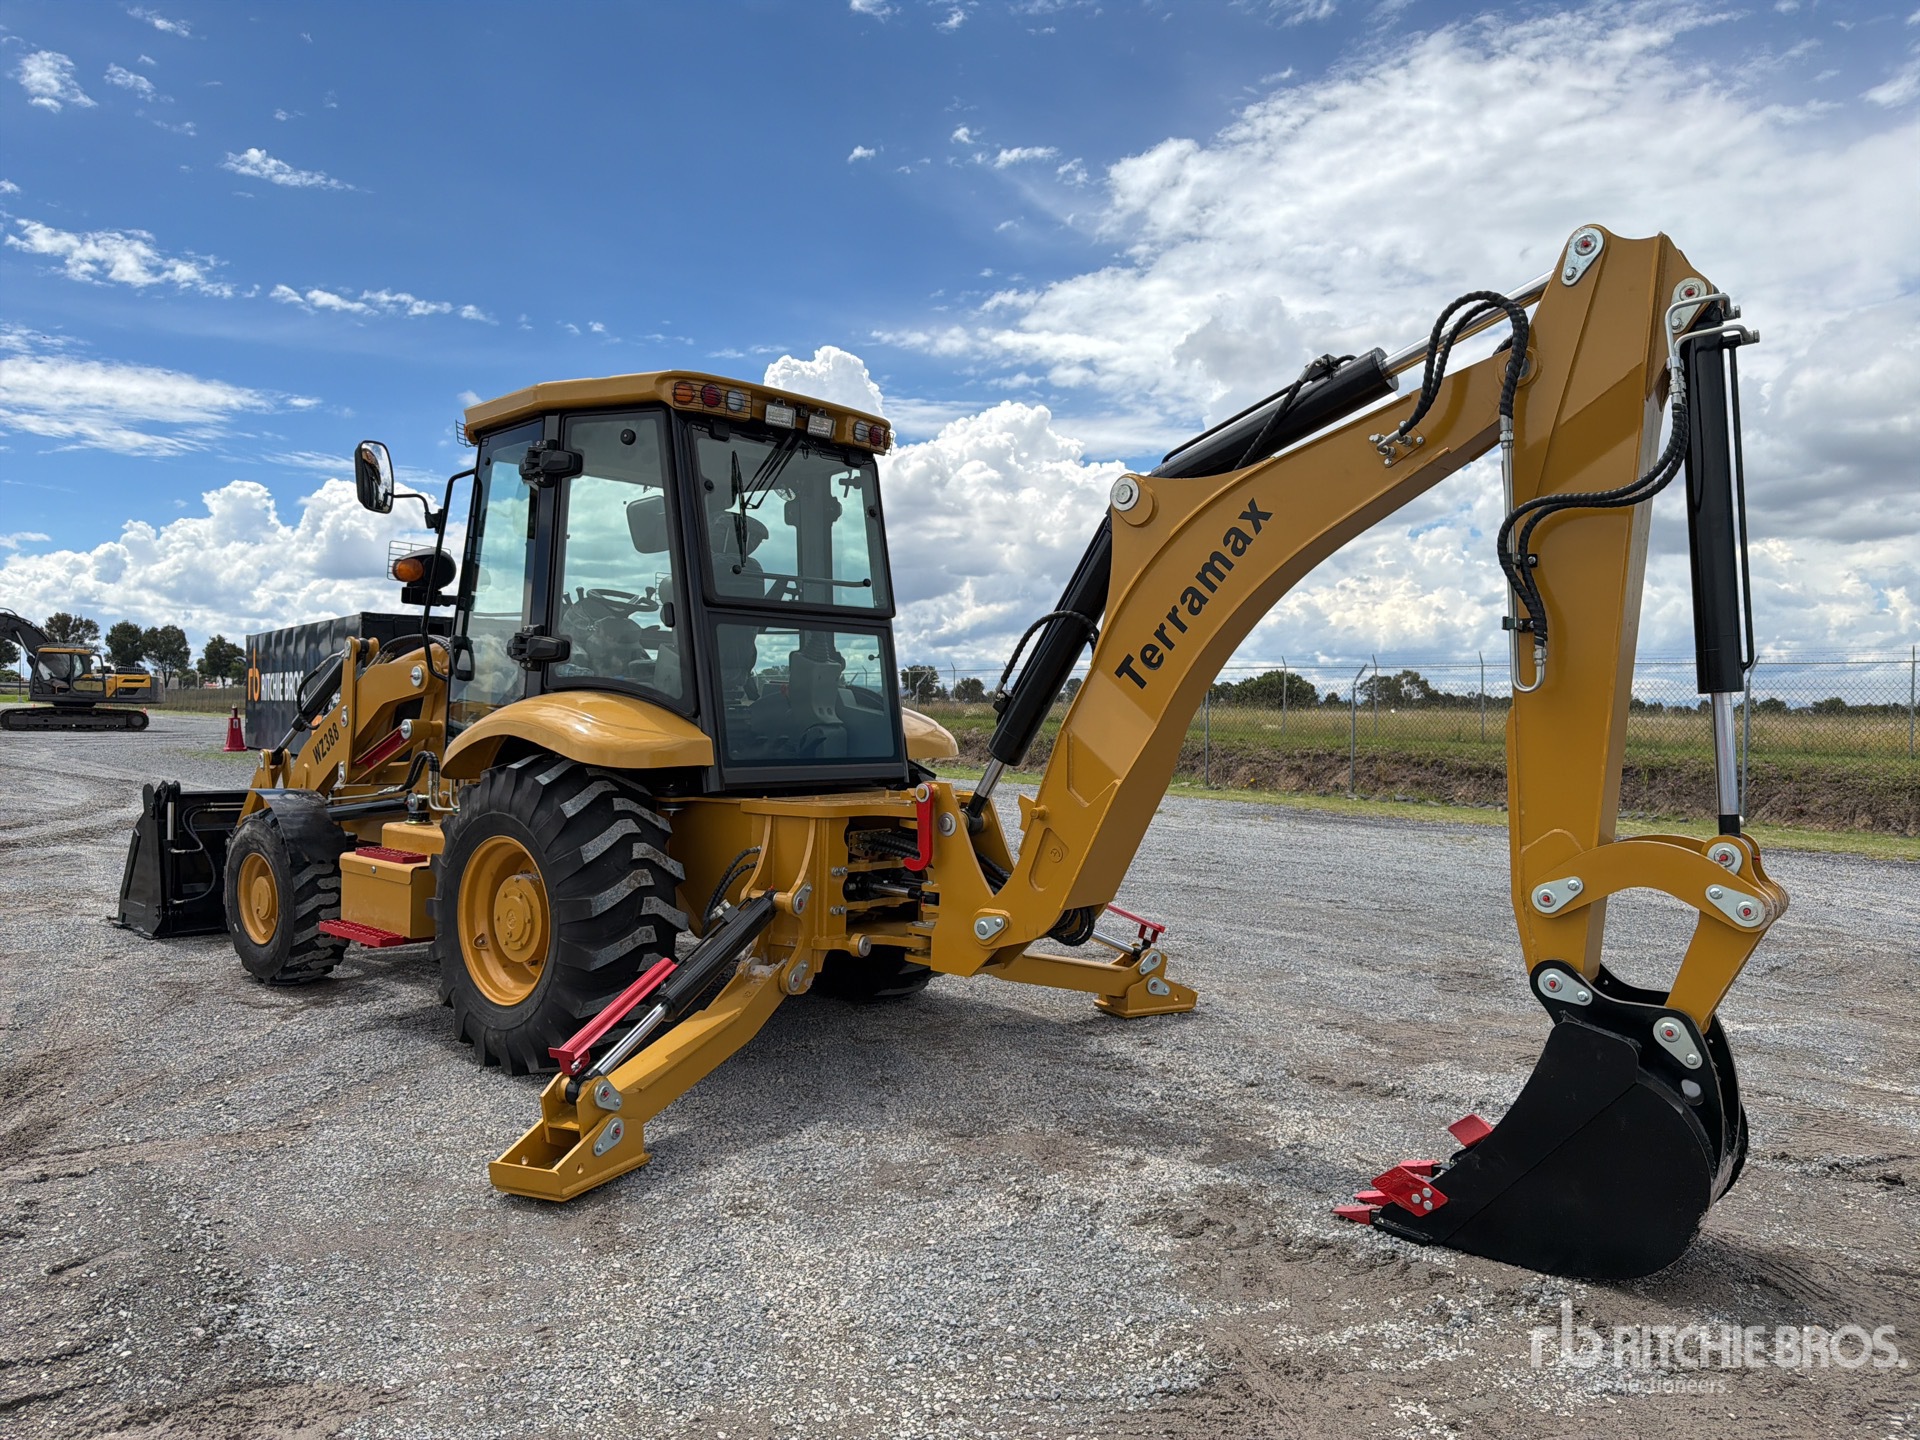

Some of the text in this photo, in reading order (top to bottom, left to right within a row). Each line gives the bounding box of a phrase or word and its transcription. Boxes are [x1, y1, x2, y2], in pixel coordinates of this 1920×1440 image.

[1114, 497, 1273, 689] Terramax
[261, 672, 283, 701] RITCHIE
[312, 722, 340, 765] WZ388
